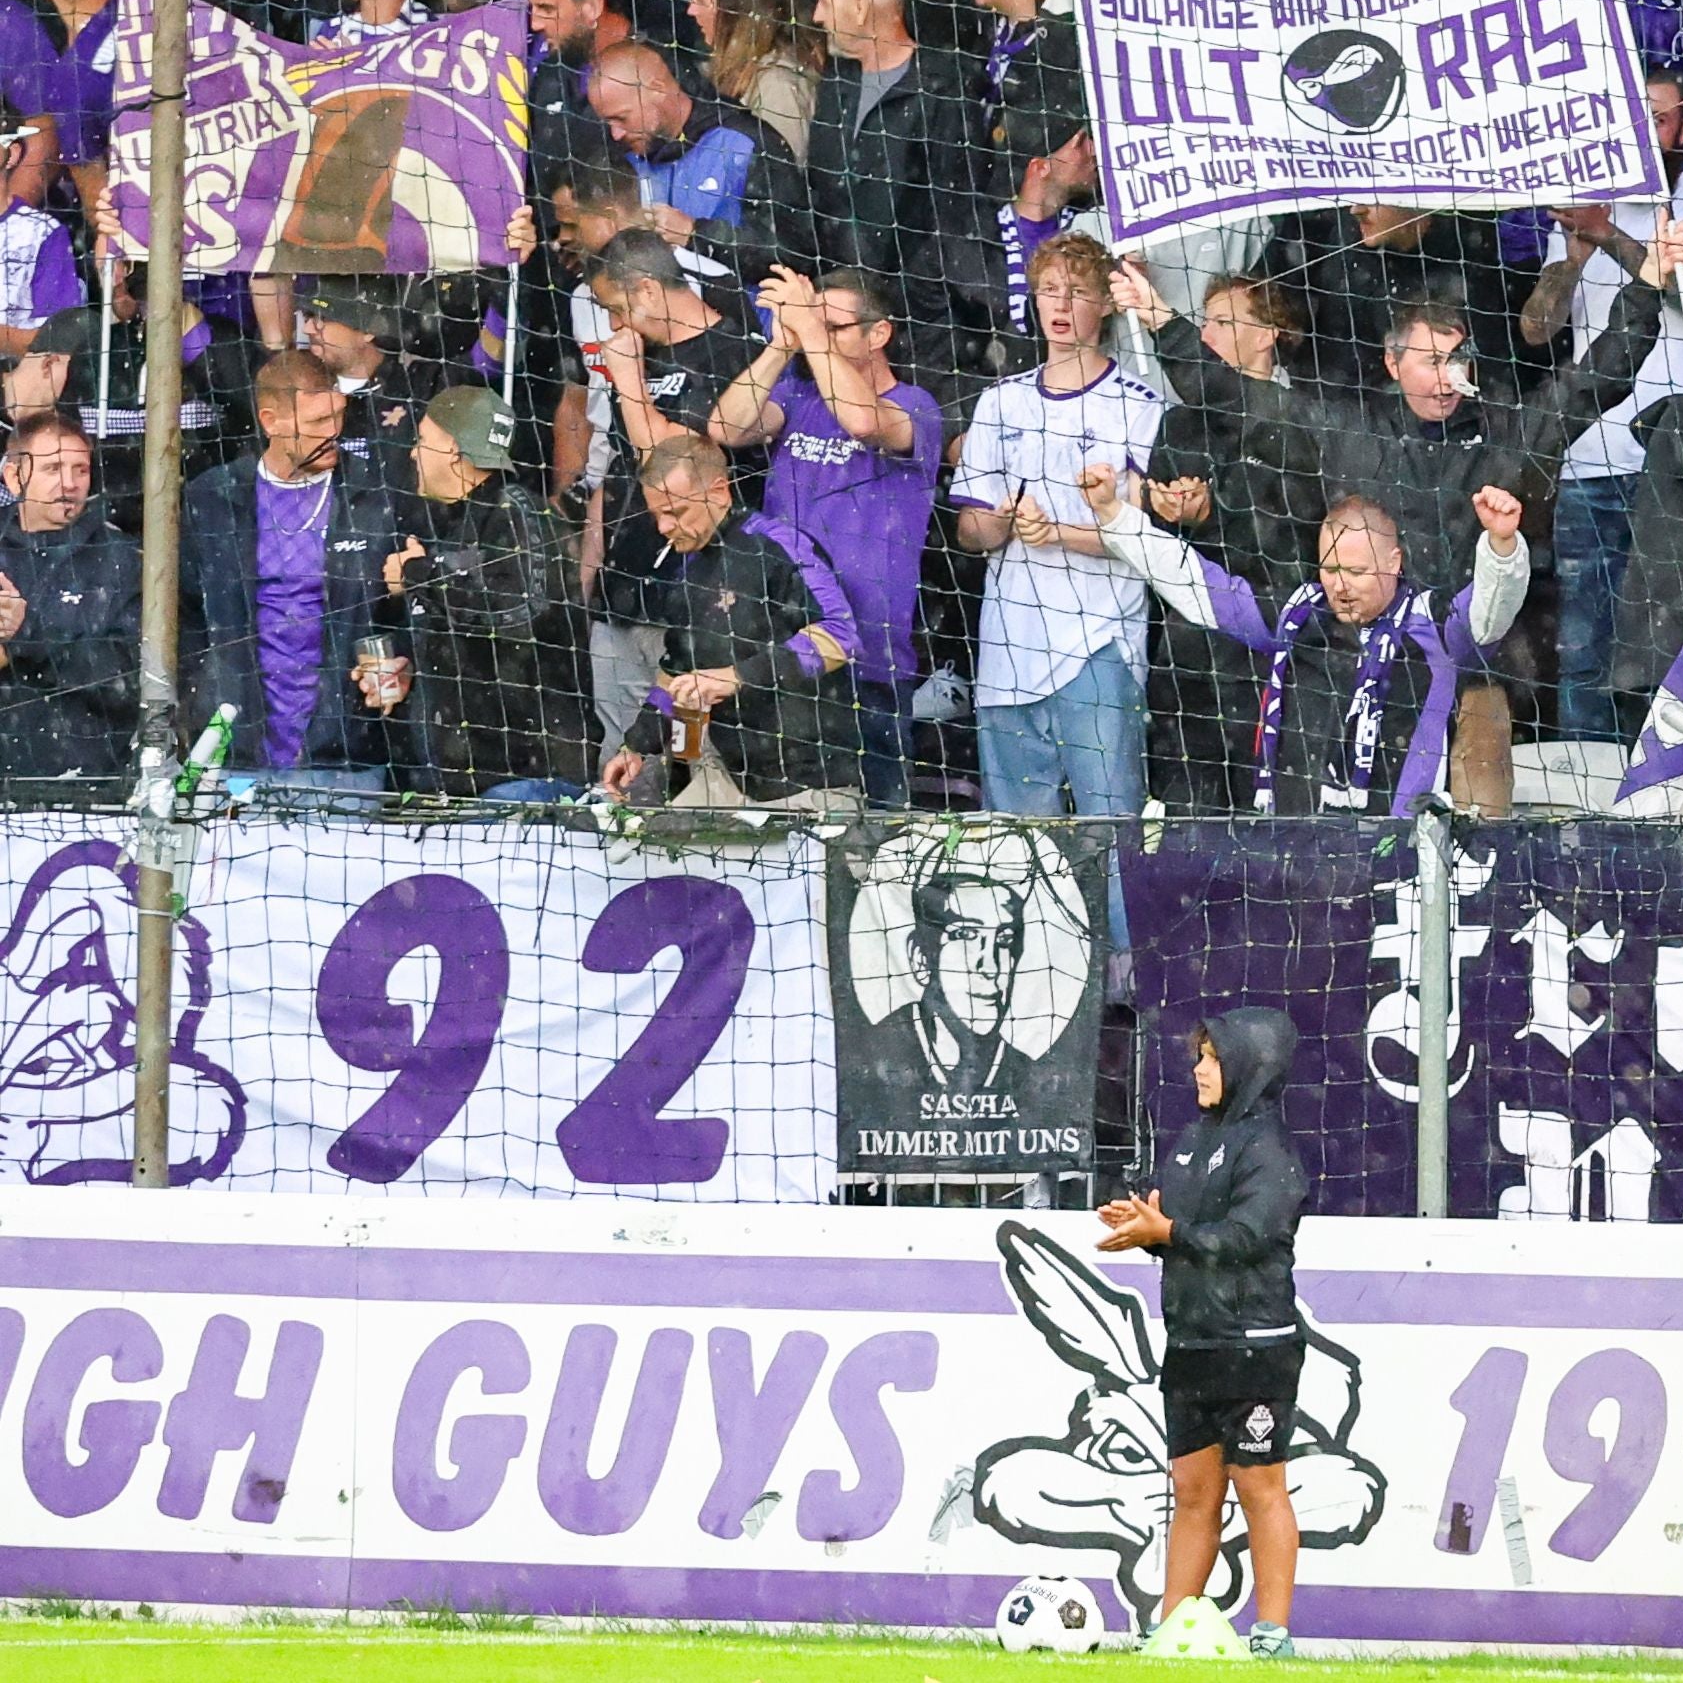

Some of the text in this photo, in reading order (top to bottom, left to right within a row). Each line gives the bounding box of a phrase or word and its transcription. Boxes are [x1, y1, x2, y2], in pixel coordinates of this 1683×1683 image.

[354, 26, 500, 97] TGS
[1115, 39, 1261, 128] ULT
[106, 101, 282, 177] AUTRIA
[1115, 137, 1175, 173] DIE
[1340, 125, 1487, 165] WERDEN
[1492, 90, 1616, 153] WEHEN
[1124, 165, 1192, 212] UND
[1203, 158, 1255, 189] WIR
[315, 873, 757, 1184] 92
[857, 1123, 1081, 1160] IMMER MIT UNS
[918, 1091, 1018, 1121] SASCHA
[0, 1305, 325, 1525] GH
[391, 1318, 938, 1541] GUYS
